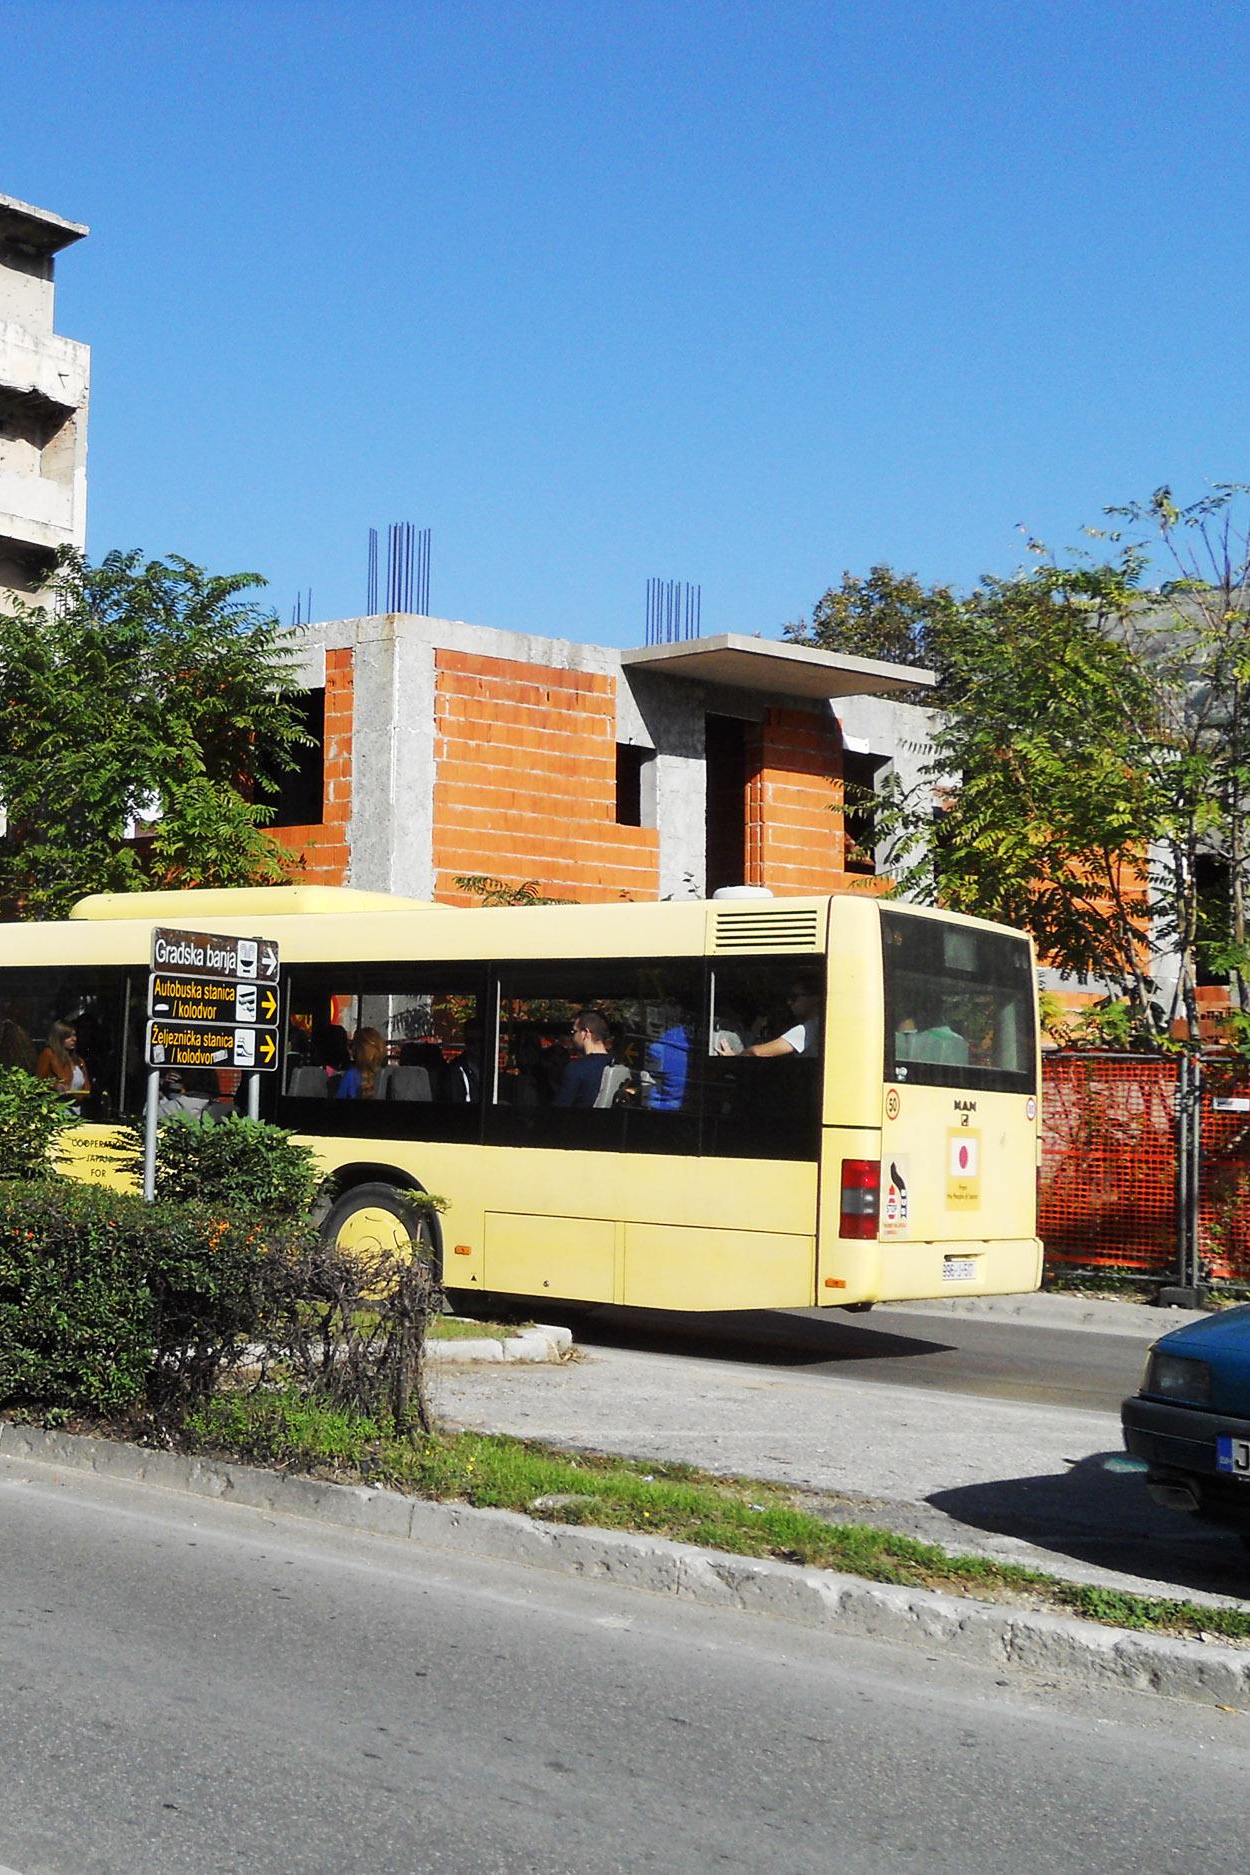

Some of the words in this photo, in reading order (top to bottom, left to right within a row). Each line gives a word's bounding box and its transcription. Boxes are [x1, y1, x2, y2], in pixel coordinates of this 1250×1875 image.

[155, 938, 204, 966] Gradska
[206, 943, 237, 975] banja
[154, 978, 202, 1000] Autobuska
[204, 983, 236, 1002] stanica
[178, 1001, 217, 1020] kolodvor
[151, 1024, 201, 1049] Željeznička
[203, 1032, 234, 1048] stanica
[177, 1047, 215, 1065] kolodvor
[954, 1100, 977, 1112] MAN
[90, 1168, 107, 1178] FOR
